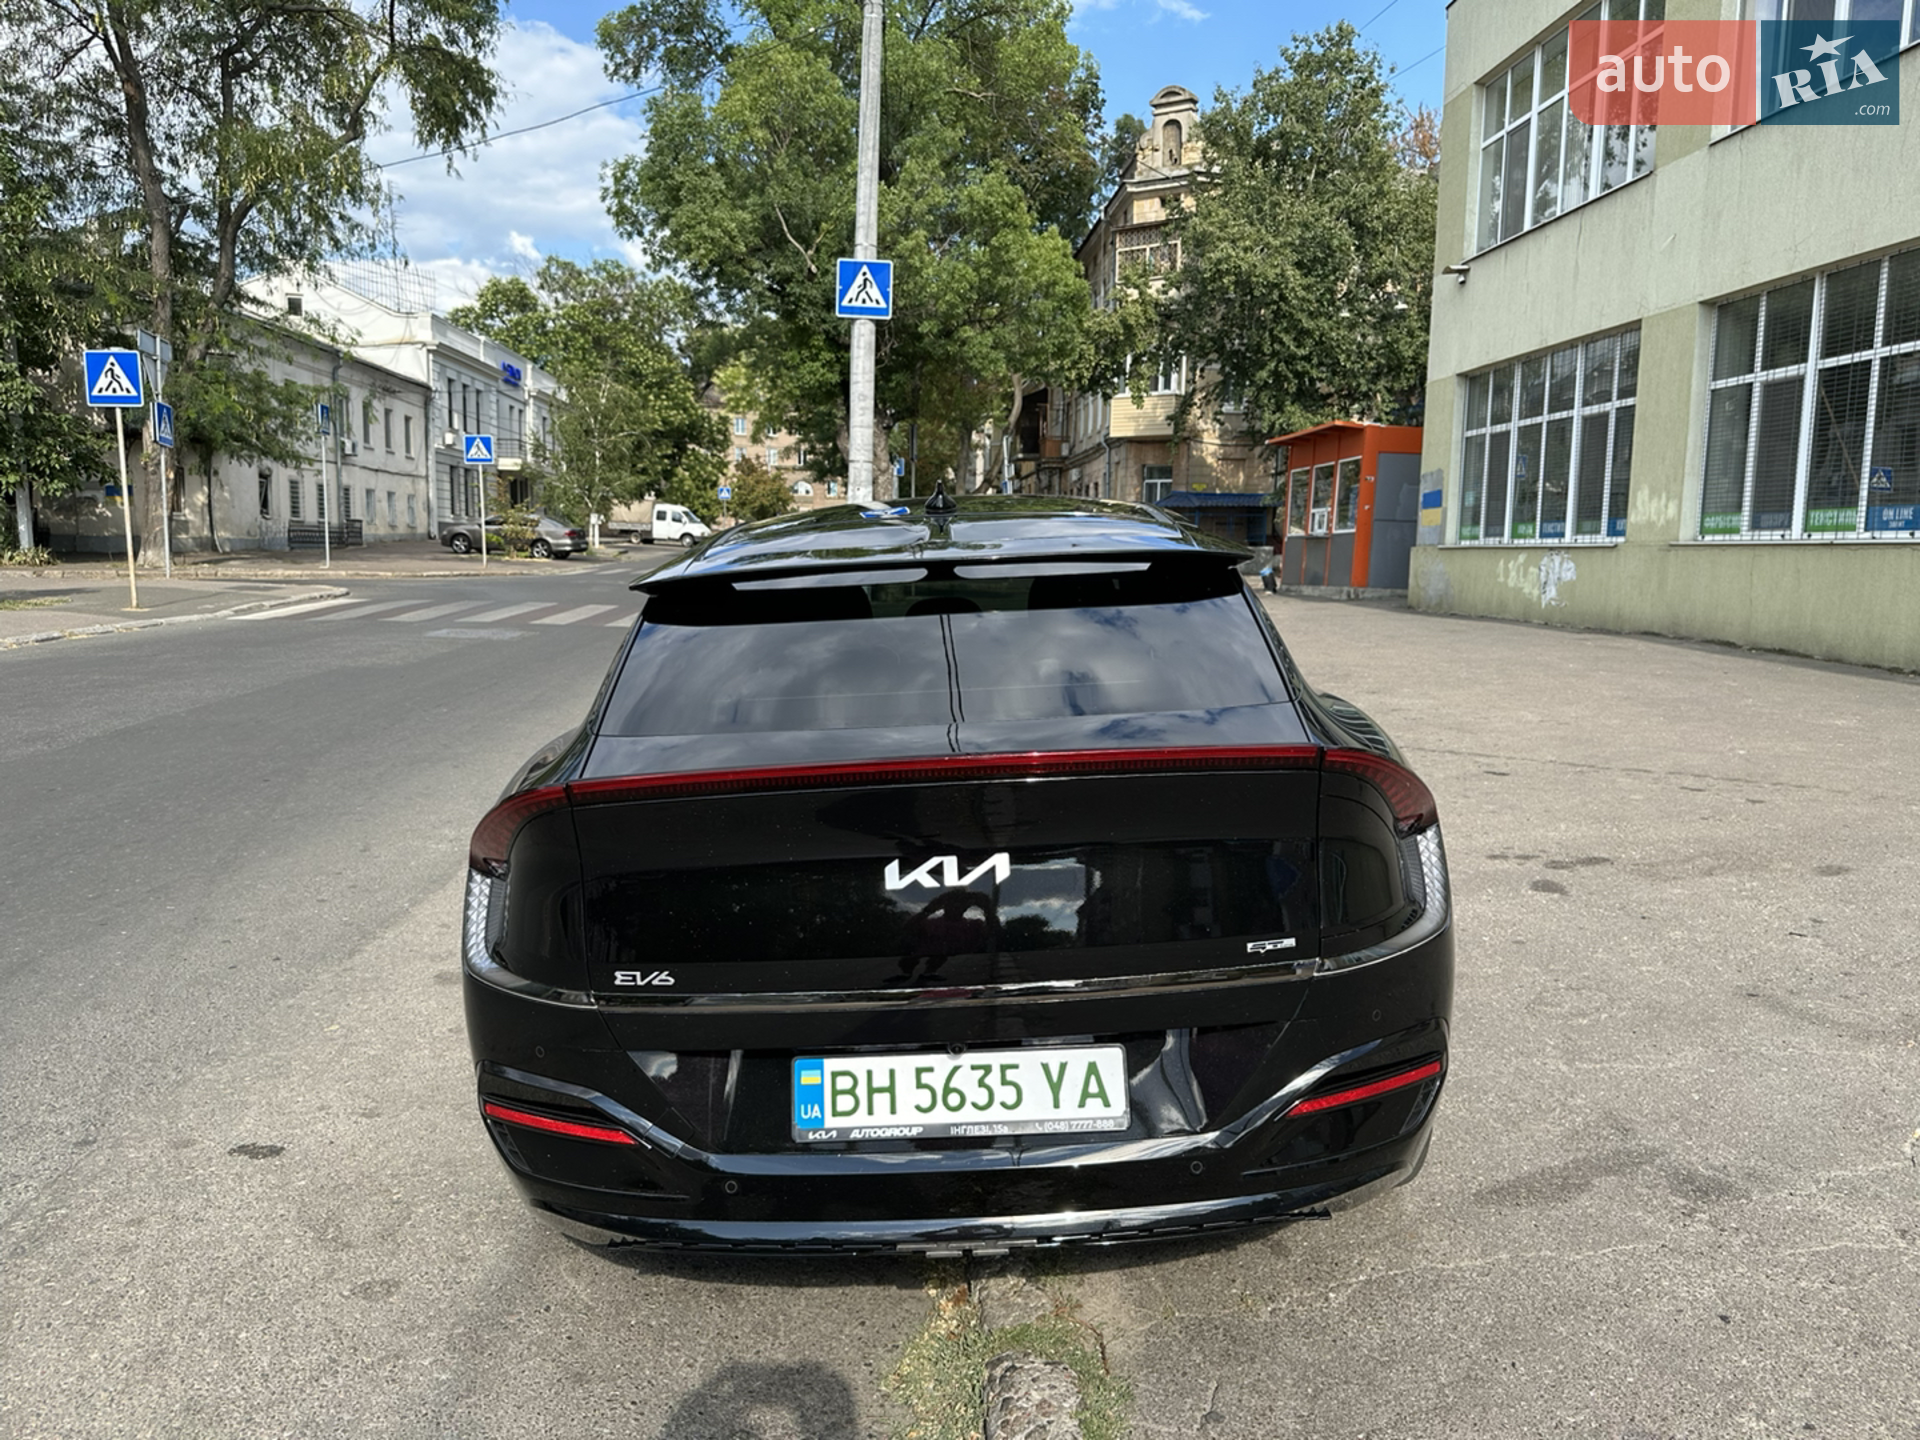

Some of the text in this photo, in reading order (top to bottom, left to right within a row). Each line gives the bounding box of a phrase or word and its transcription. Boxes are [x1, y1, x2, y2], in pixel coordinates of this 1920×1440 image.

[884, 852, 1011, 890] KIA
[614, 970, 675, 986] EV6
[830, 1060, 1112, 1118] BH 5635 YA
[800, 1103, 822, 1119] UA
[850, 1126, 924, 1138] AUTOGROUP
[1044, 1121, 1069, 1133] (048)
